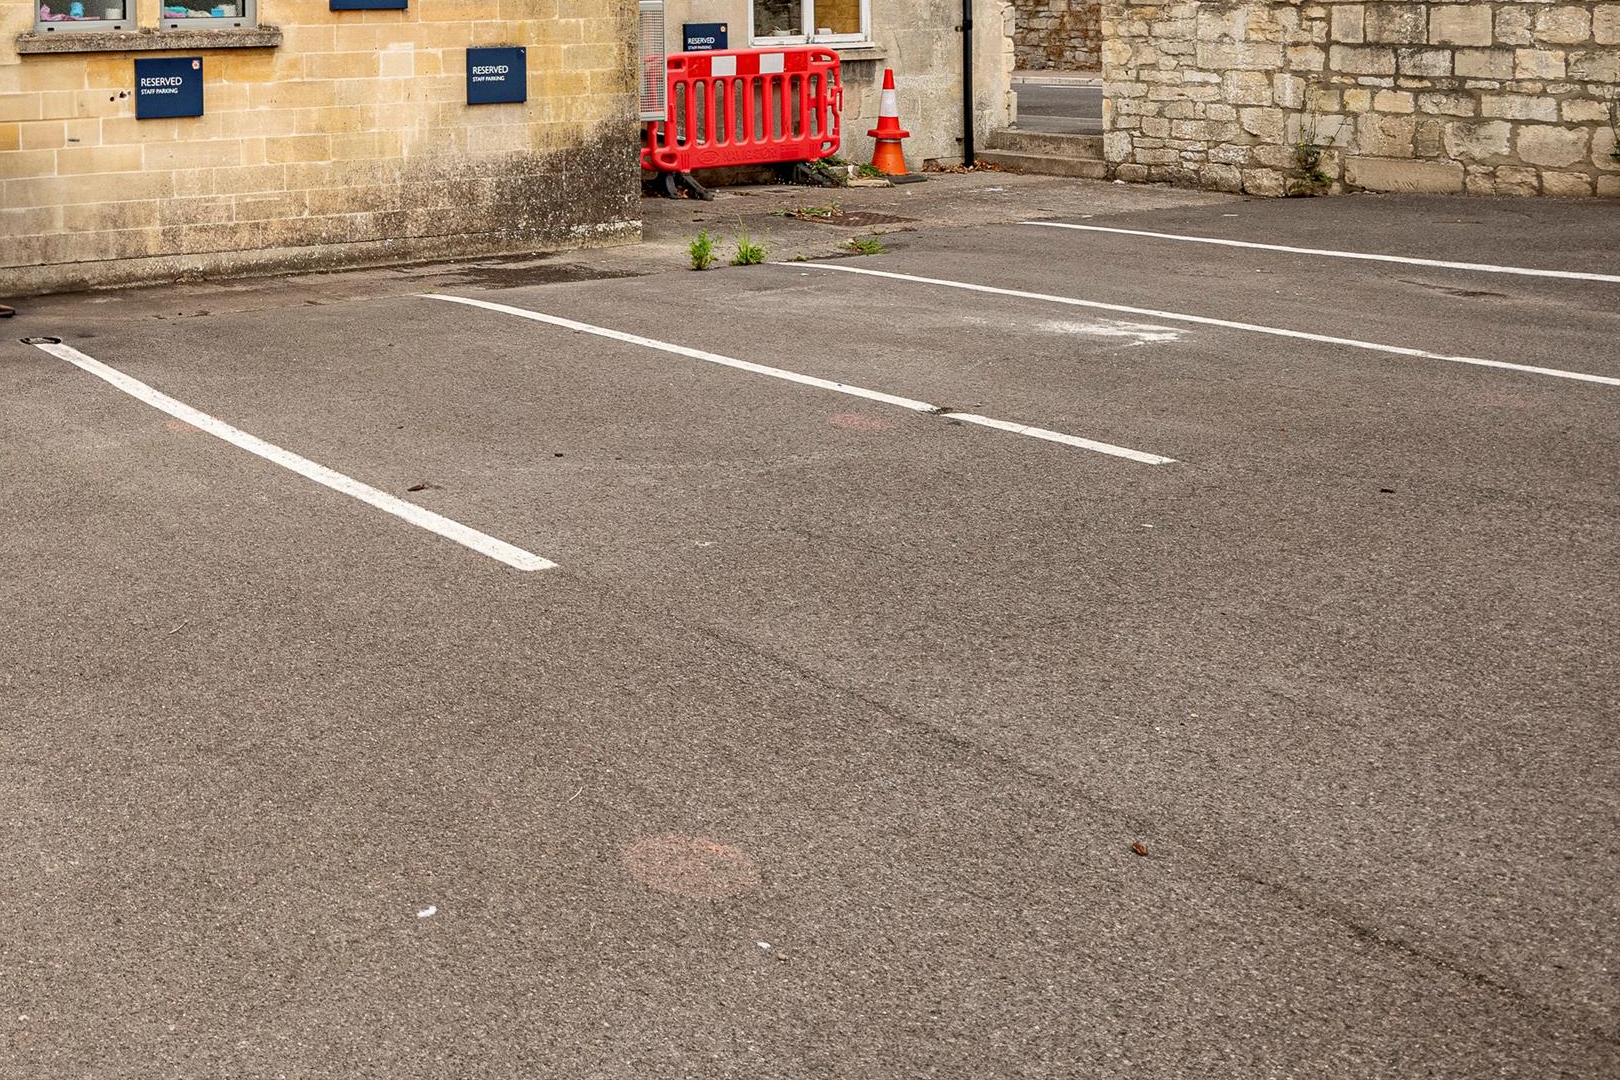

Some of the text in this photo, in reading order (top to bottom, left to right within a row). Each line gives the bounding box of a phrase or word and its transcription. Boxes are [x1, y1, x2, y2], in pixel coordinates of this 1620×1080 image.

[687, 37, 716, 45] RESERVED
[472, 65, 509, 75] RESERVED
[140, 76, 183, 87] RESERVED
